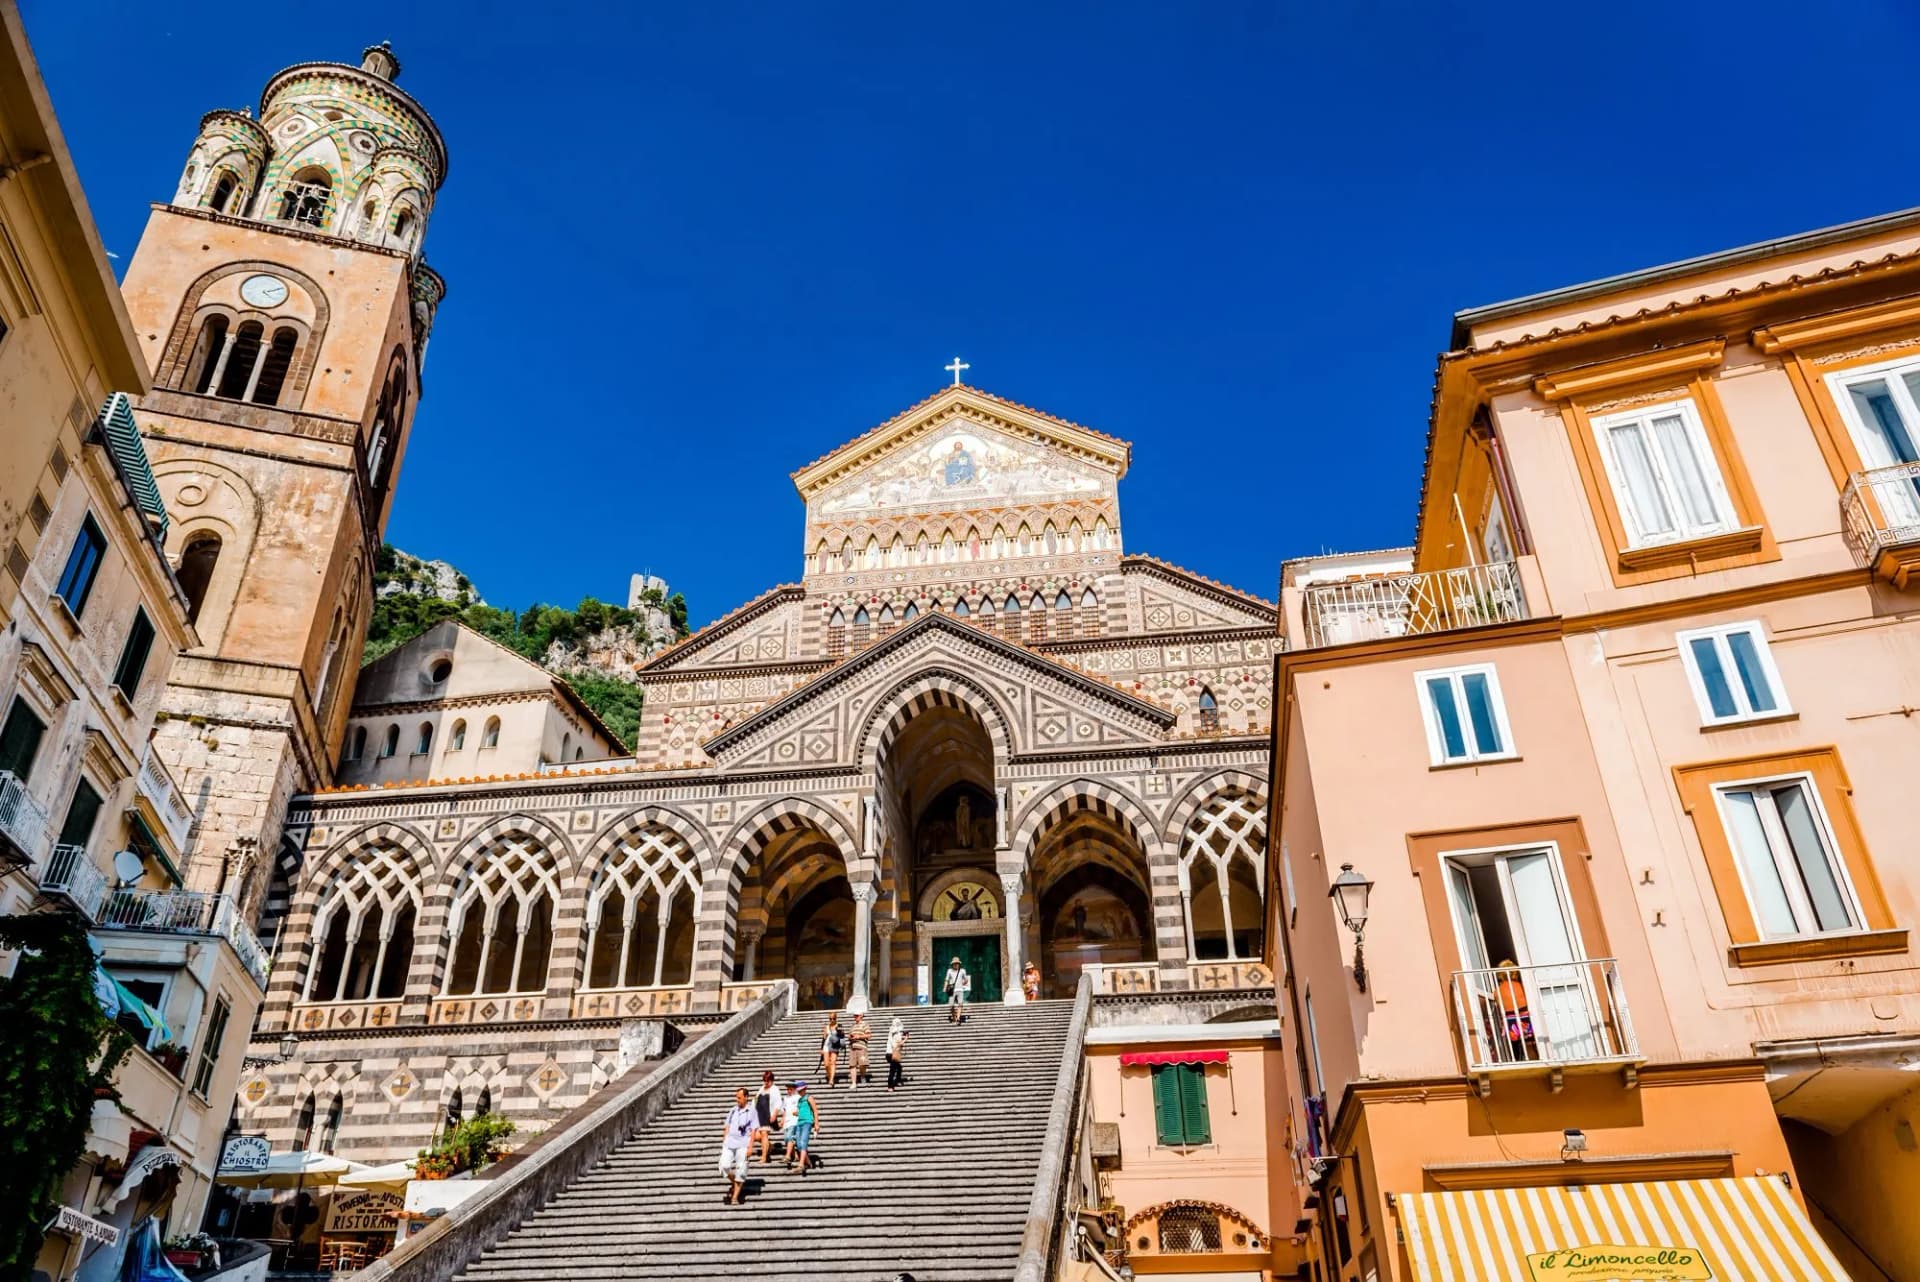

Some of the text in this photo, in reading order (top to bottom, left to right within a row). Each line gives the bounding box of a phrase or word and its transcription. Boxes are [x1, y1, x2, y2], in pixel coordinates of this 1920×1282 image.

[226, 1138, 267, 1157] RISTORANTE
[223, 1157, 267, 1165] CHIOSTRO
[337, 1192, 370, 1213] TAVERNA
[63, 1211, 94, 1234] RISTORANTE
[1540, 1251, 1692, 1269] il Limoncello
